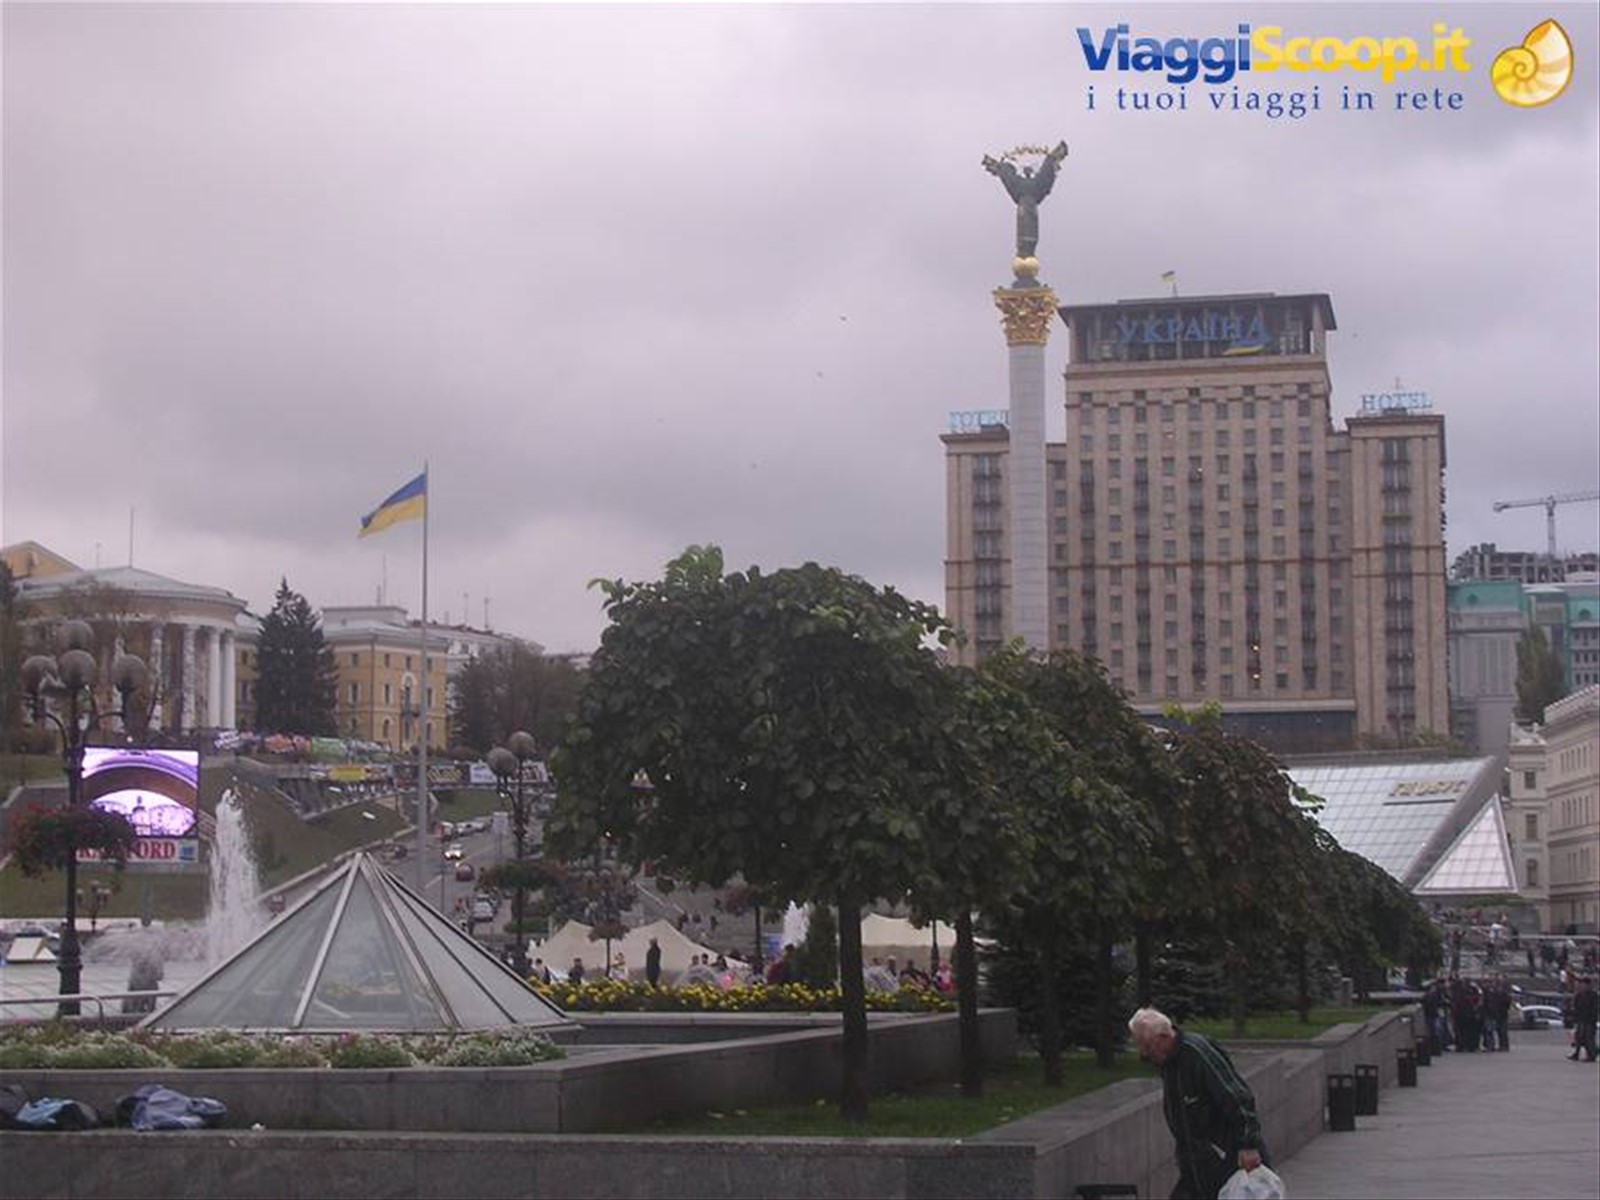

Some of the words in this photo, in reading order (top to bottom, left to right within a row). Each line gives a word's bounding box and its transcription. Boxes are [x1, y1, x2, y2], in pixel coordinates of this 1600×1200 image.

[1117, 311, 1271, 343] УКРАЇНА
[1362, 392, 1433, 411] HOTEL
[948, 410, 1009, 428] ГОТЕЛ
